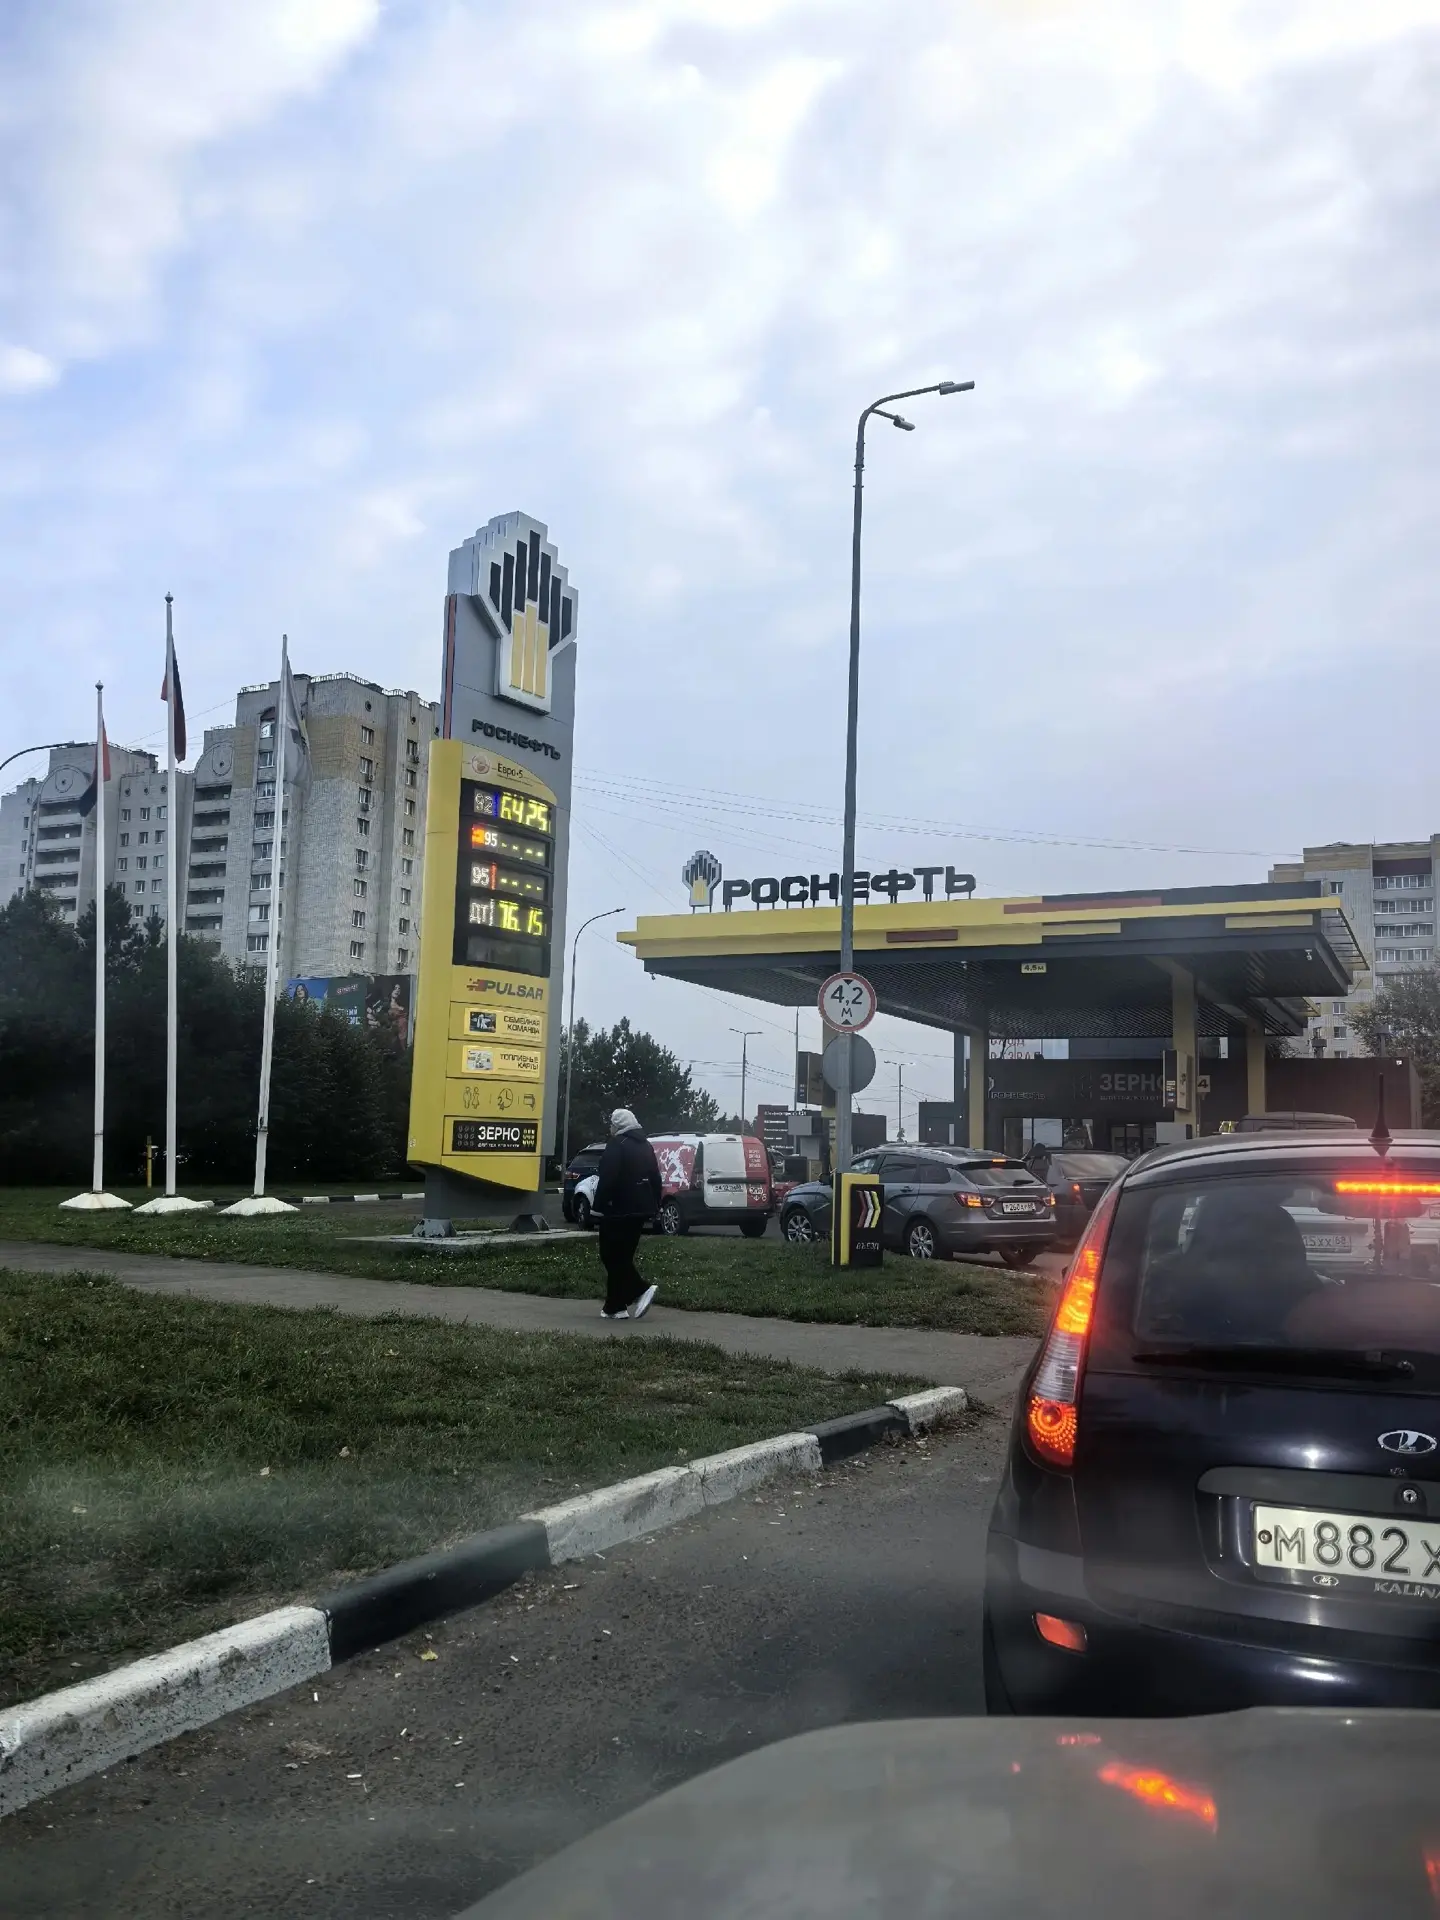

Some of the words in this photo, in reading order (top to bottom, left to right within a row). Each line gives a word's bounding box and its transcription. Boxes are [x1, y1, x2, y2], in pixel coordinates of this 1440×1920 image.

[472, 718, 561, 761] РОСНЕФТЬ
[474, 792, 493, 814] 92
[484, 831, 498, 847] 95
[472, 866, 490, 886] 95
[722, 866, 977, 906] РОСНЕФТЬ
[469, 902, 489, 925] ДТ
[484, 980, 544, 1001] PULSAR
[830, 985, 864, 1007] 4,2
[507, 1024, 540, 1035] КОМАНДА
[517, 1062, 539, 1071] КАРТЫ
[1197, 1078, 1209, 1089] 4
[477, 1125, 521, 1142] ЗЕРНО
